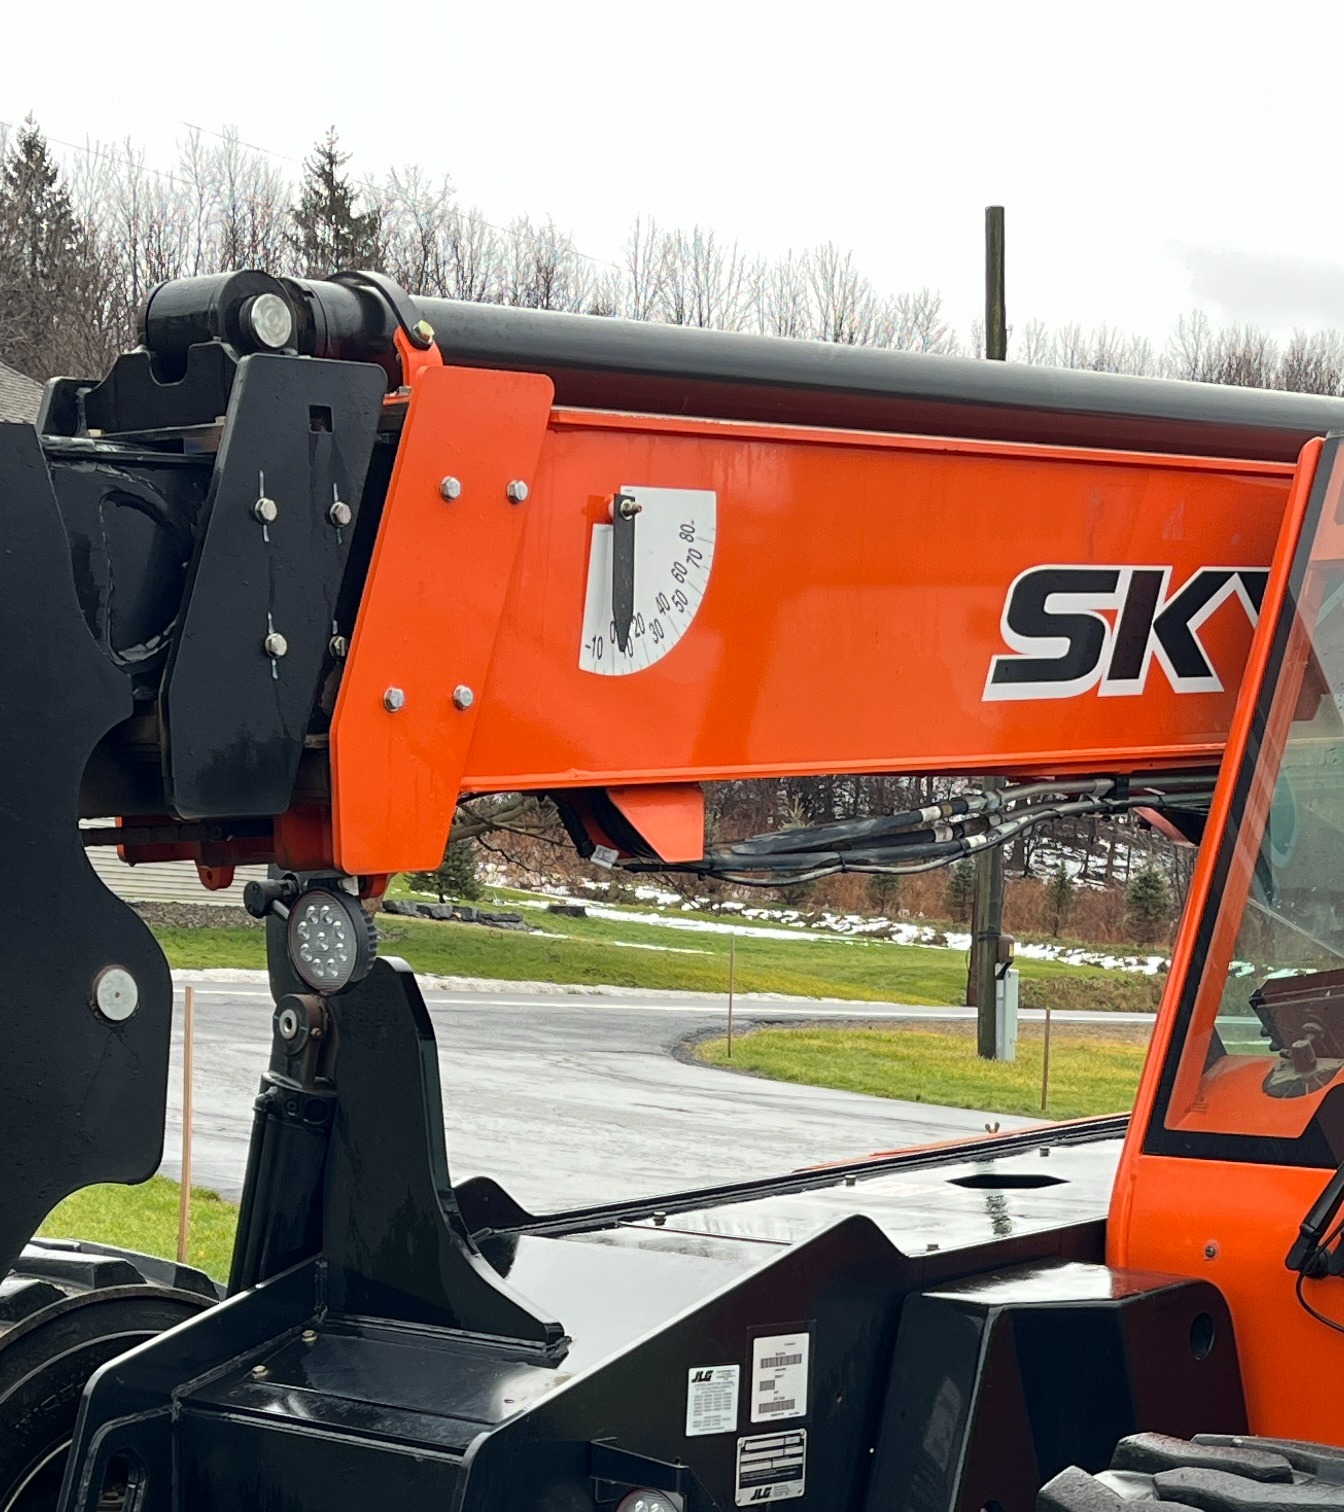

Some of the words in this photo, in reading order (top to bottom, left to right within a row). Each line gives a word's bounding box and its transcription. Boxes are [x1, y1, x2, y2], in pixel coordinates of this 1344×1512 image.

[686, 548, 703, 568] 70
[671, 561, 688, 583] 60
[655, 592, 671, 615] 40
[671, 589, 688, 613] 50
[632, 612, 645, 638] 20
[649, 618, 664, 644] 30
[691, 1370, 714, 1383] JLG
[750, 1486, 773, 1502] JLG
